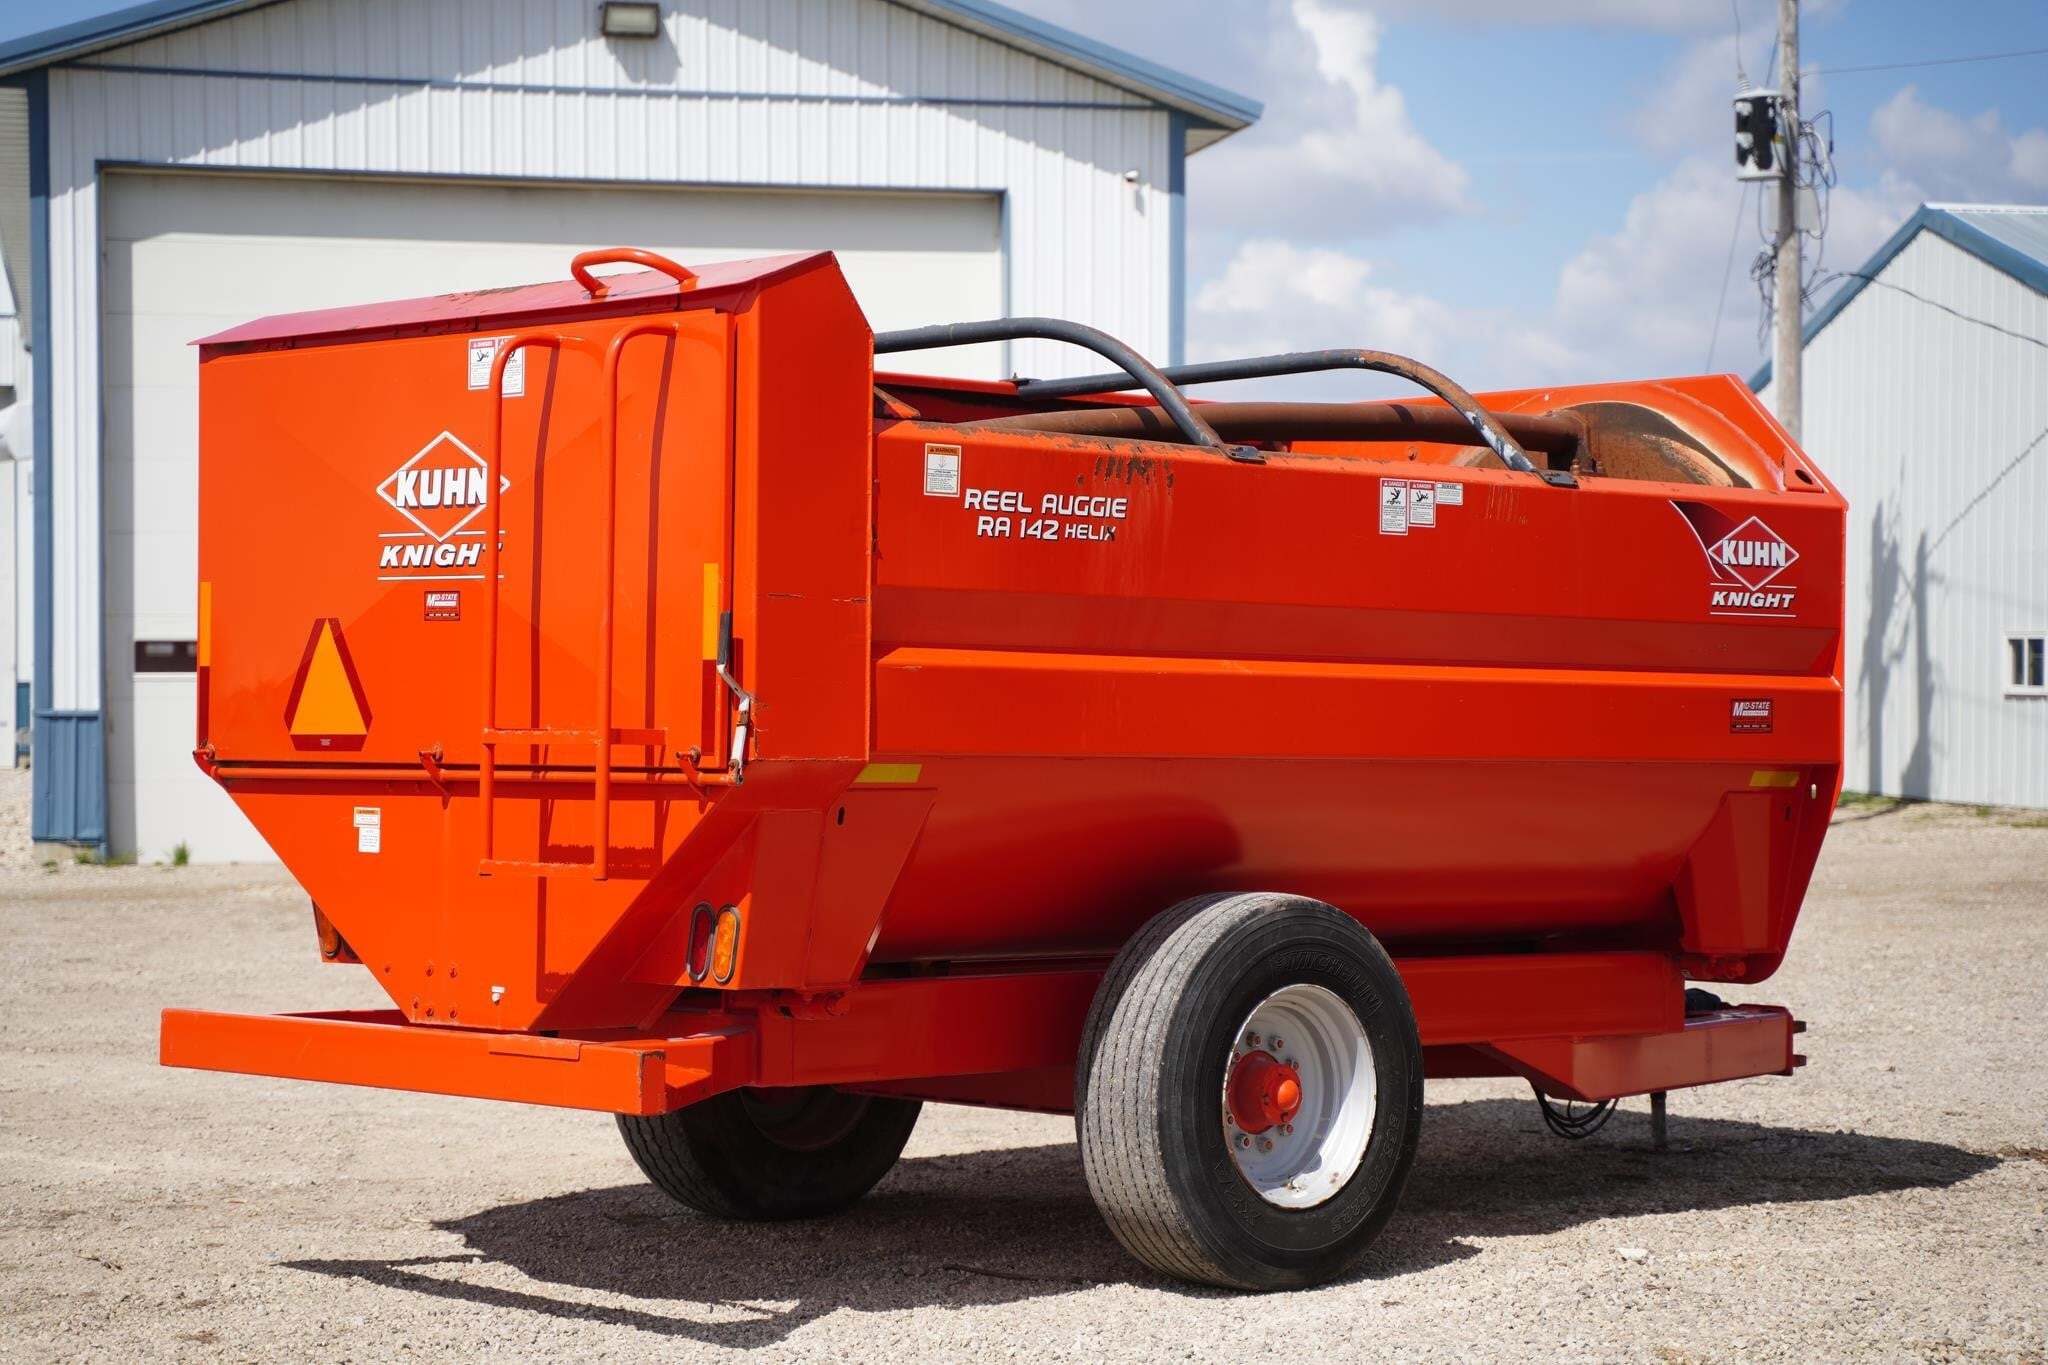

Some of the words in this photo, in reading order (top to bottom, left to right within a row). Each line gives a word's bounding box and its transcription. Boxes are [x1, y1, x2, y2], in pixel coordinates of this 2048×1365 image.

[396, 467, 488, 509] KUHN
[964, 488, 1033, 514] REEL
[1041, 493, 1128, 519] AUGGIE
[976, 515, 1011, 538] RA
[1019, 518, 1060, 541] 142
[379, 543, 503, 569] KNIGH
[1722, 539, 1786, 567] KUHN
[1711, 591, 1795, 609] KNIGHT
[1732, 701, 1771, 717] MID-STATE
